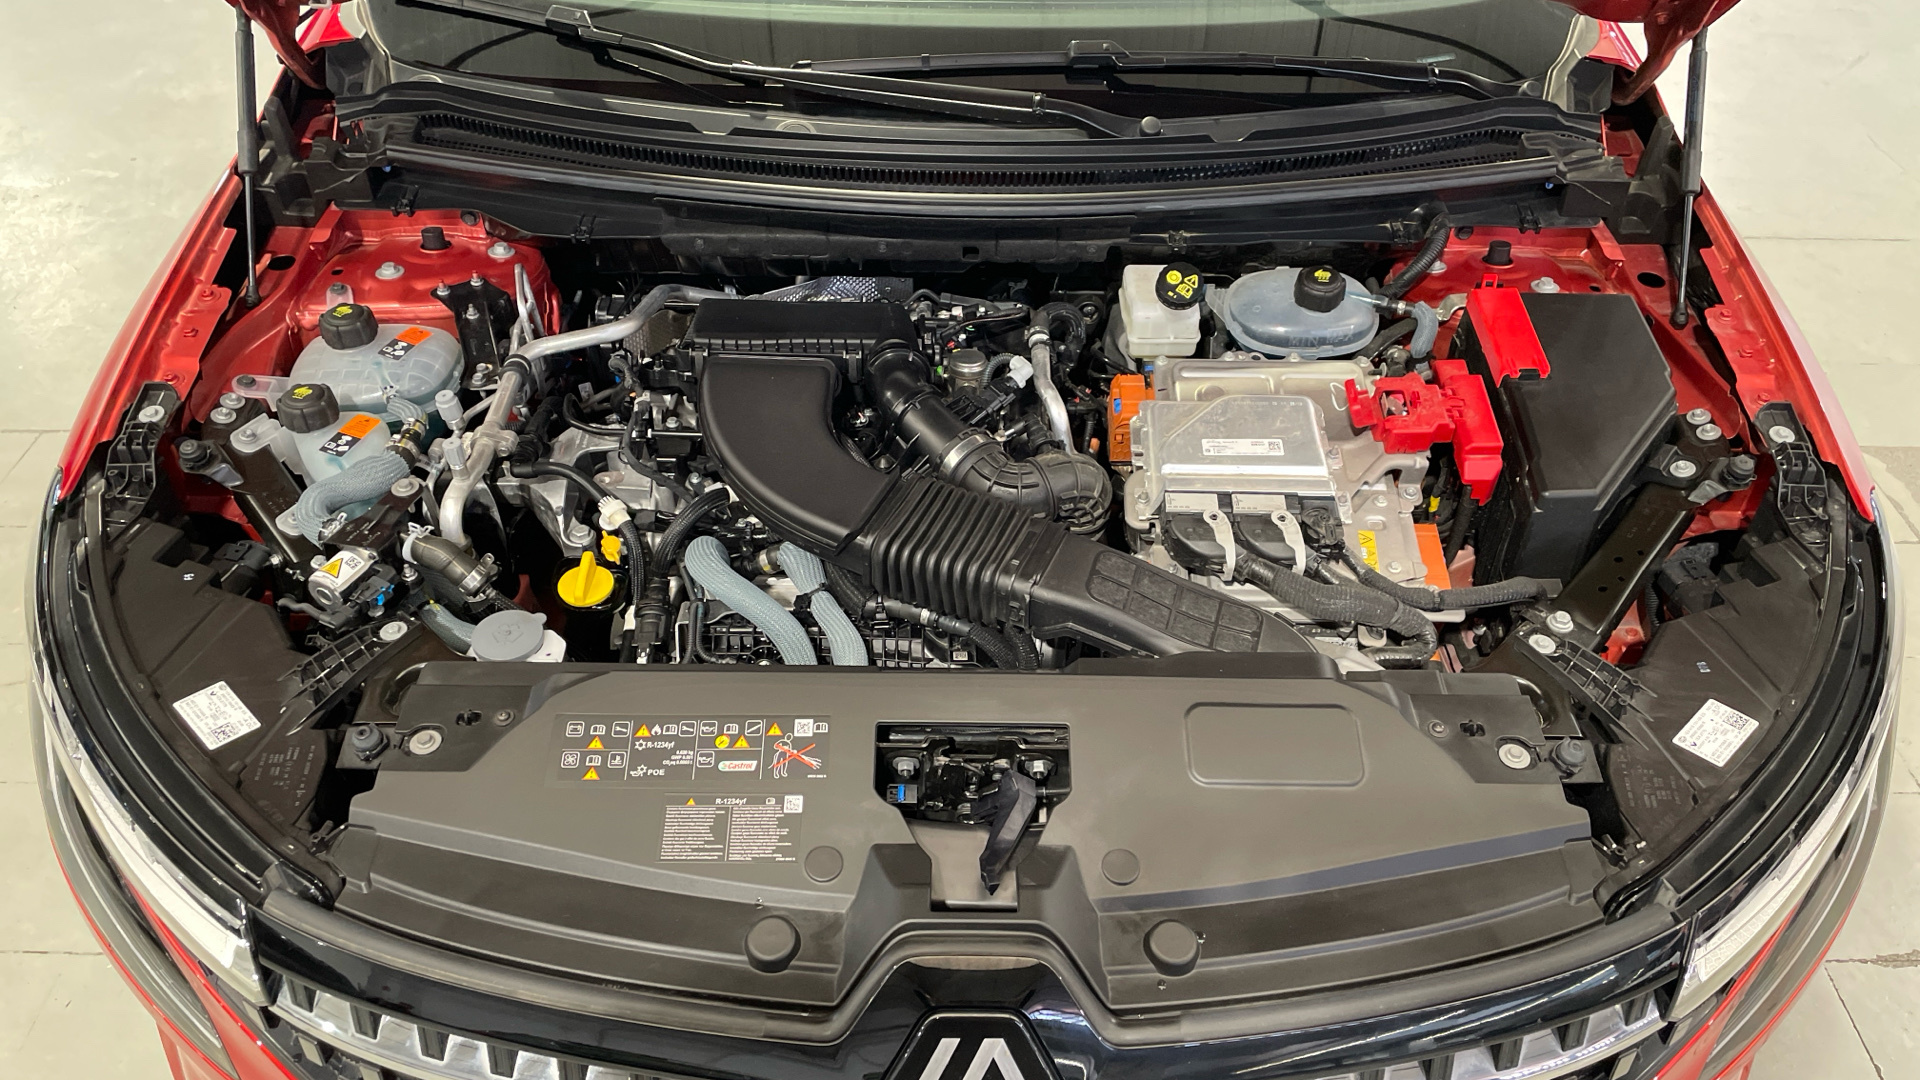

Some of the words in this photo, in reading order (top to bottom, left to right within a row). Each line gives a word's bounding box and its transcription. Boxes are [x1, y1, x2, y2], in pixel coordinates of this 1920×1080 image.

[1288, 336, 1320, 348] MIN
[646, 741, 675, 750] R-1234yf
[727, 762, 754, 770] Castrol
[715, 797, 747, 806] R-1234yf
